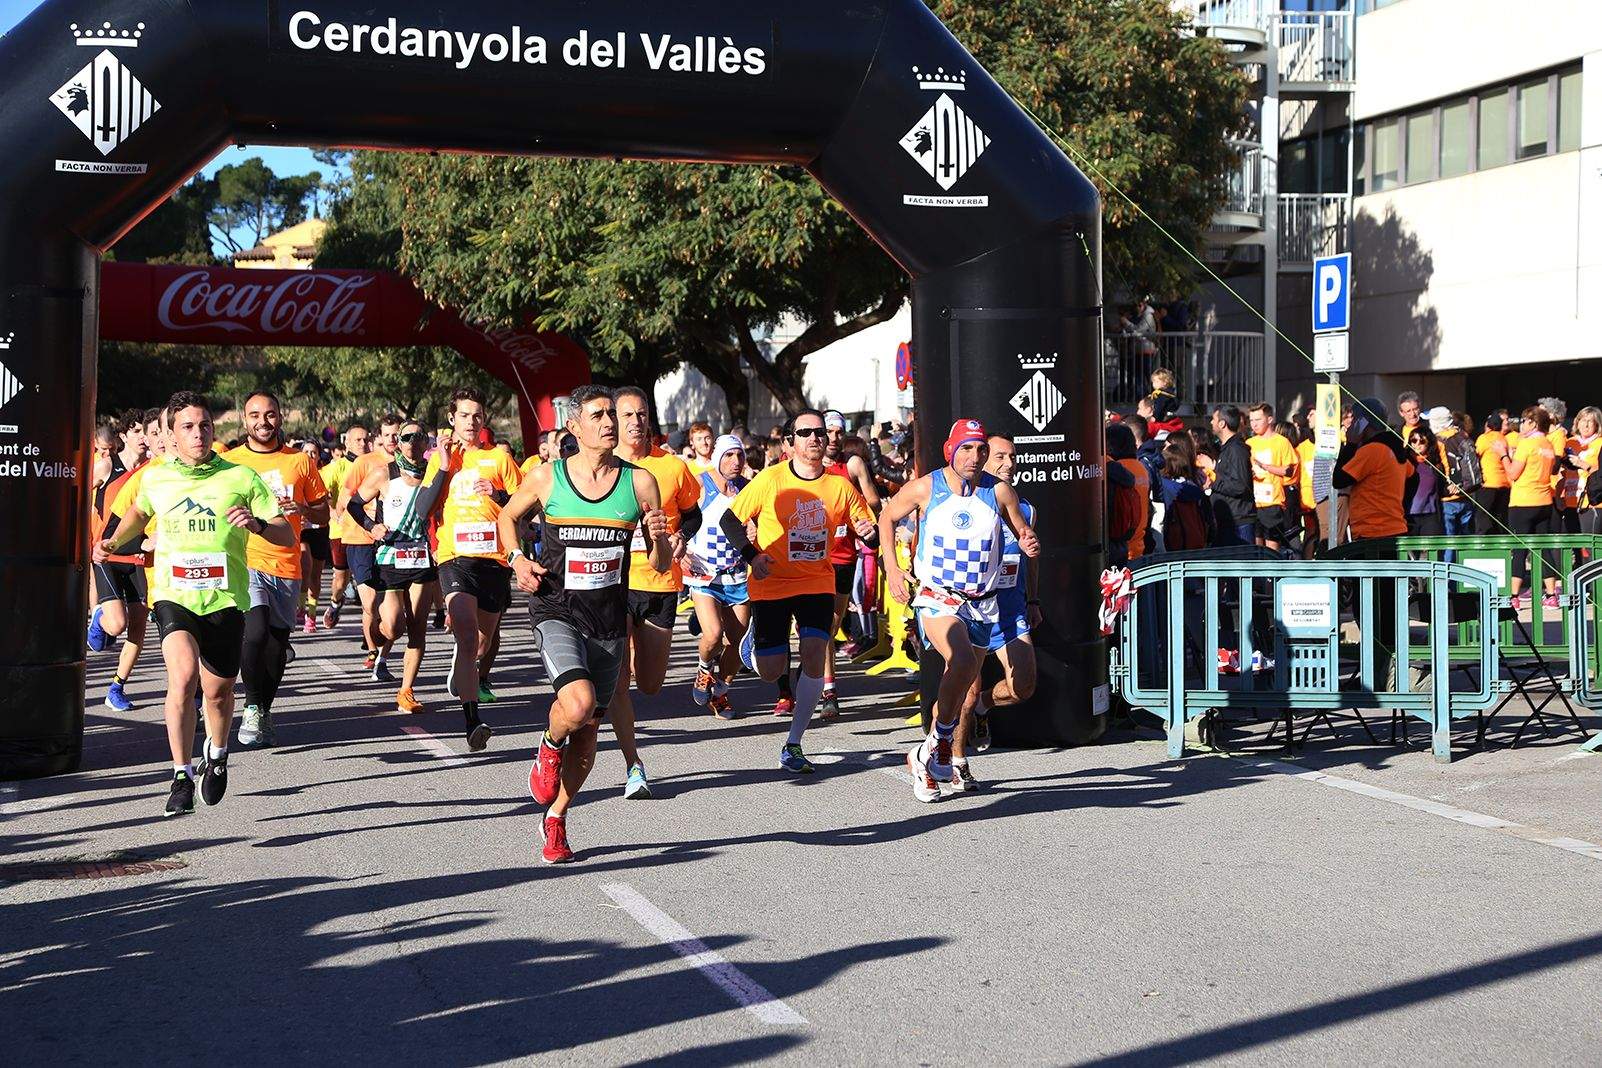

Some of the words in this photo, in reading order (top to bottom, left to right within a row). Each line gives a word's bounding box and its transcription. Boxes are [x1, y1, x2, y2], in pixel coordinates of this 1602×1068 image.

[288, 10, 548, 69] Cerdanyola
[562, 29, 626, 70] del
[639, 32, 767, 76] Vallès
[61, 162, 91, 171] FACTA
[114, 165, 143, 173] VERBA
[908, 197, 934, 205] FACTA
[956, 198, 984, 206] VERBA
[1319, 264, 1342, 323] P
[158, 270, 377, 334] Coca-Cola
[22, 443, 40, 455] de
[1068, 450, 1081, 461] de
[0, 460, 27, 477] del
[33, 461, 77, 478] Vallès
[1011, 467, 1047, 487] yola
[1051, 466, 1073, 481] del
[1076, 463, 1104, 479] Vallès
[188, 519, 216, 532] RUN
[558, 527, 615, 542] CERDANYOLA
[803, 543, 816, 551] 75
[184, 568, 210, 579] 293
[583, 562, 608, 573] 180
